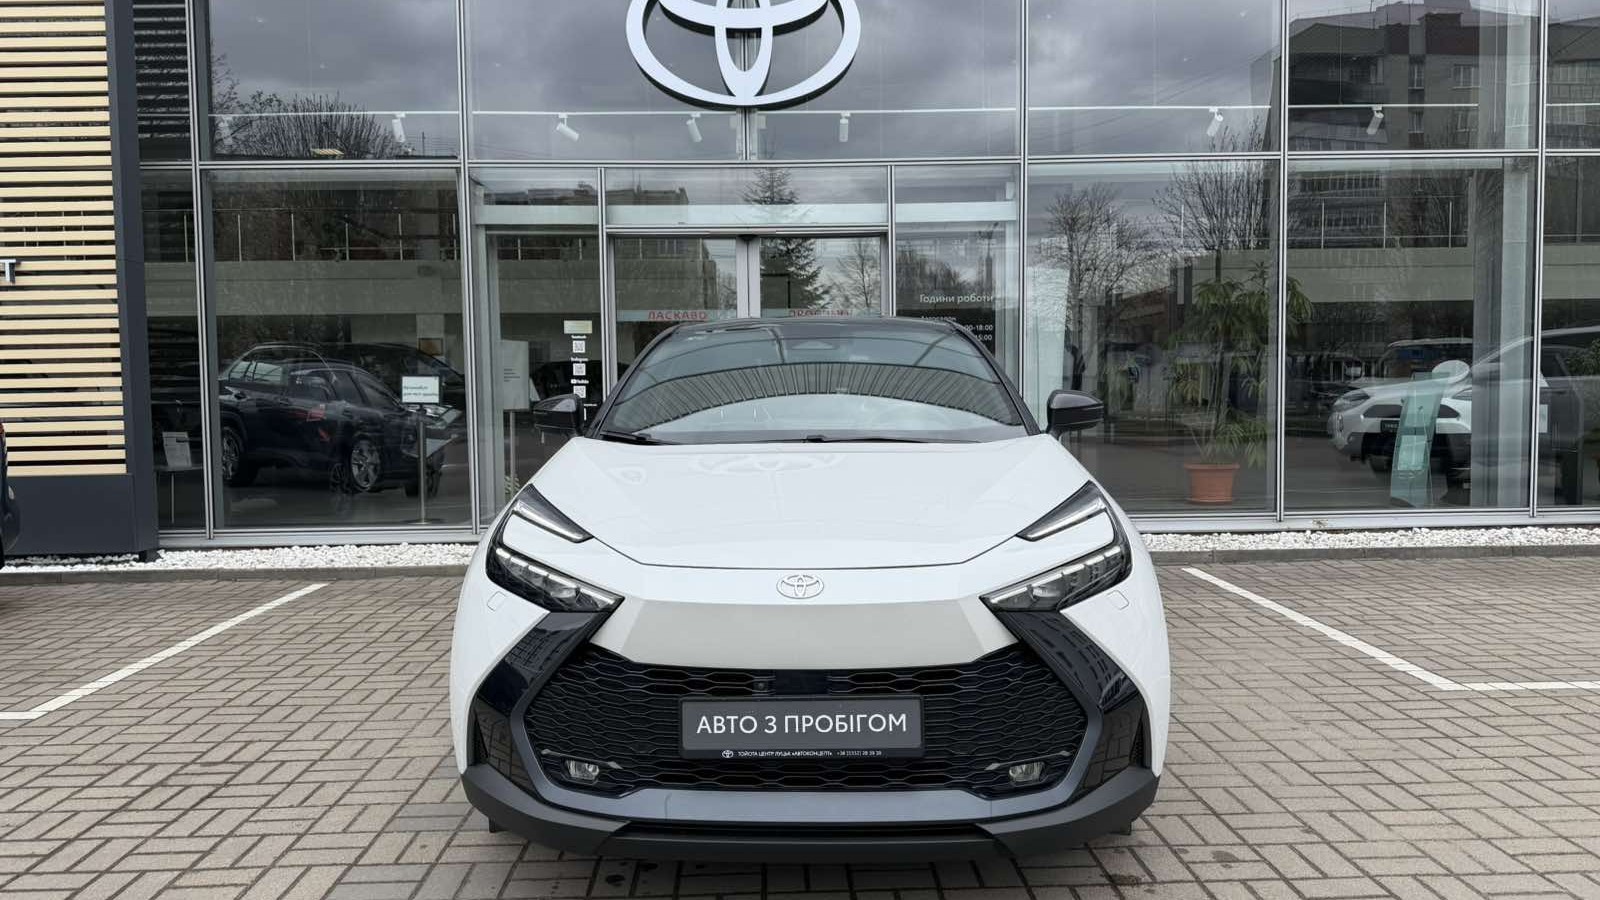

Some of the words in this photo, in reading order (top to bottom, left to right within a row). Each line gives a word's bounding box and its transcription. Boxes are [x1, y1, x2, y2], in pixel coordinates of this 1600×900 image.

[919, 293, 955, 303] Години
[957, 292, 993, 304] роботи
[648, 310, 706, 320] ЛАСКАВО
[696, 715, 758, 734] АВТО
[764, 715, 777, 734] З
[784, 713, 907, 733] ПРОБІГОМ
